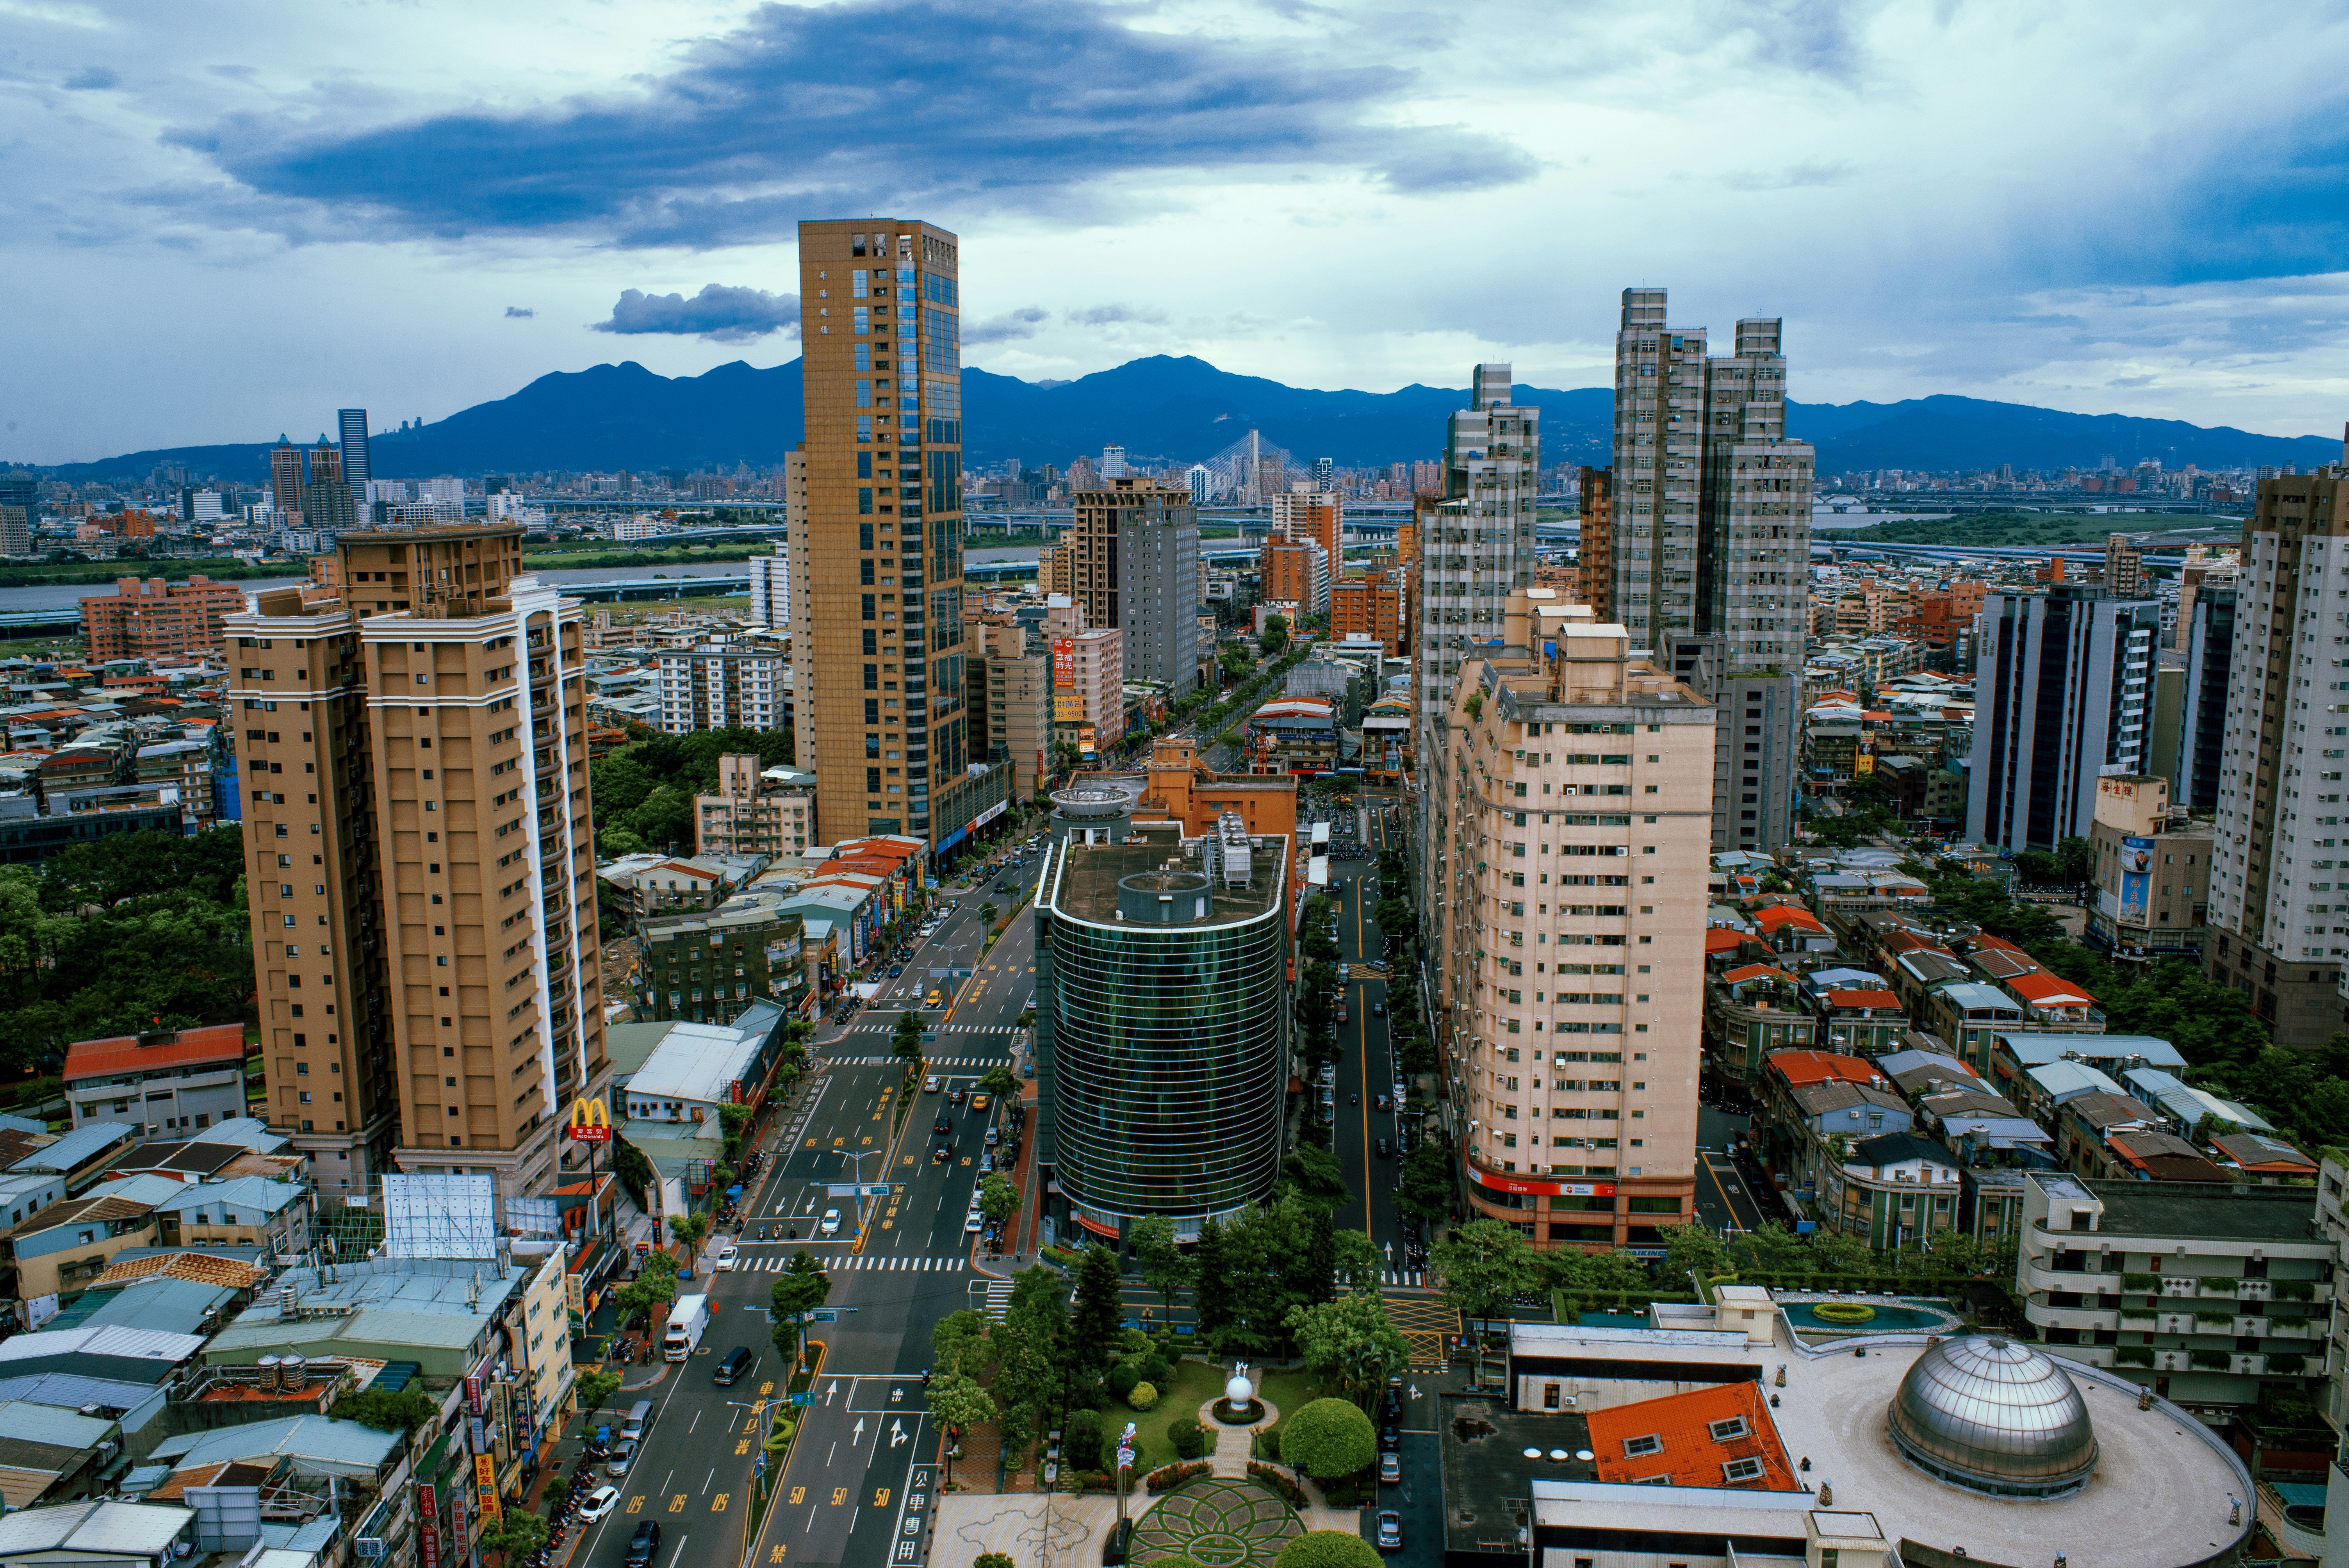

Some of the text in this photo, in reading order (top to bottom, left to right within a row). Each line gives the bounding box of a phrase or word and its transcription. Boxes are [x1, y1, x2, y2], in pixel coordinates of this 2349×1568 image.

[1056, 653, 1072, 661] 幸福
[1056, 661, 1072, 670] 時光
[2101, 782, 2133, 797] 海生樓
[2127, 877, 2141, 913] 海生樓
[2113, 941, 2144, 956] 海生樓
[872, 1087, 893, 1121] 禁行機車
[806, 1138, 817, 1147] 50
[834, 1137, 845, 1146] 50
[862, 1136, 873, 1145] 50
[903, 1156, 914, 1165] 50
[961, 1157, 971, 1166] 50
[882, 1186, 904, 1230] 禁行機車
[517, 1390, 530, 1450] 宏昇水族館
[479, 1468, 491, 1484] 好友
[481, 1496, 494, 1512] 設備
[668, 1494, 687, 1513] 50
[711, 1493, 730, 1512] 50
[788, 1486, 806, 1505] 50
[831, 1488, 848, 1506] 50
[873, 1488, 891, 1507] 50
[626, 1495, 645, 1514] 50
[898, 1471, 928, 1559] 公車專用
[423, 1525, 435, 1534] Spa
[454, 1501, 467, 1554] 伊諾華地板
[358, 1542, 380, 1556] 復健
[768, 1545, 787, 1565] 禁
